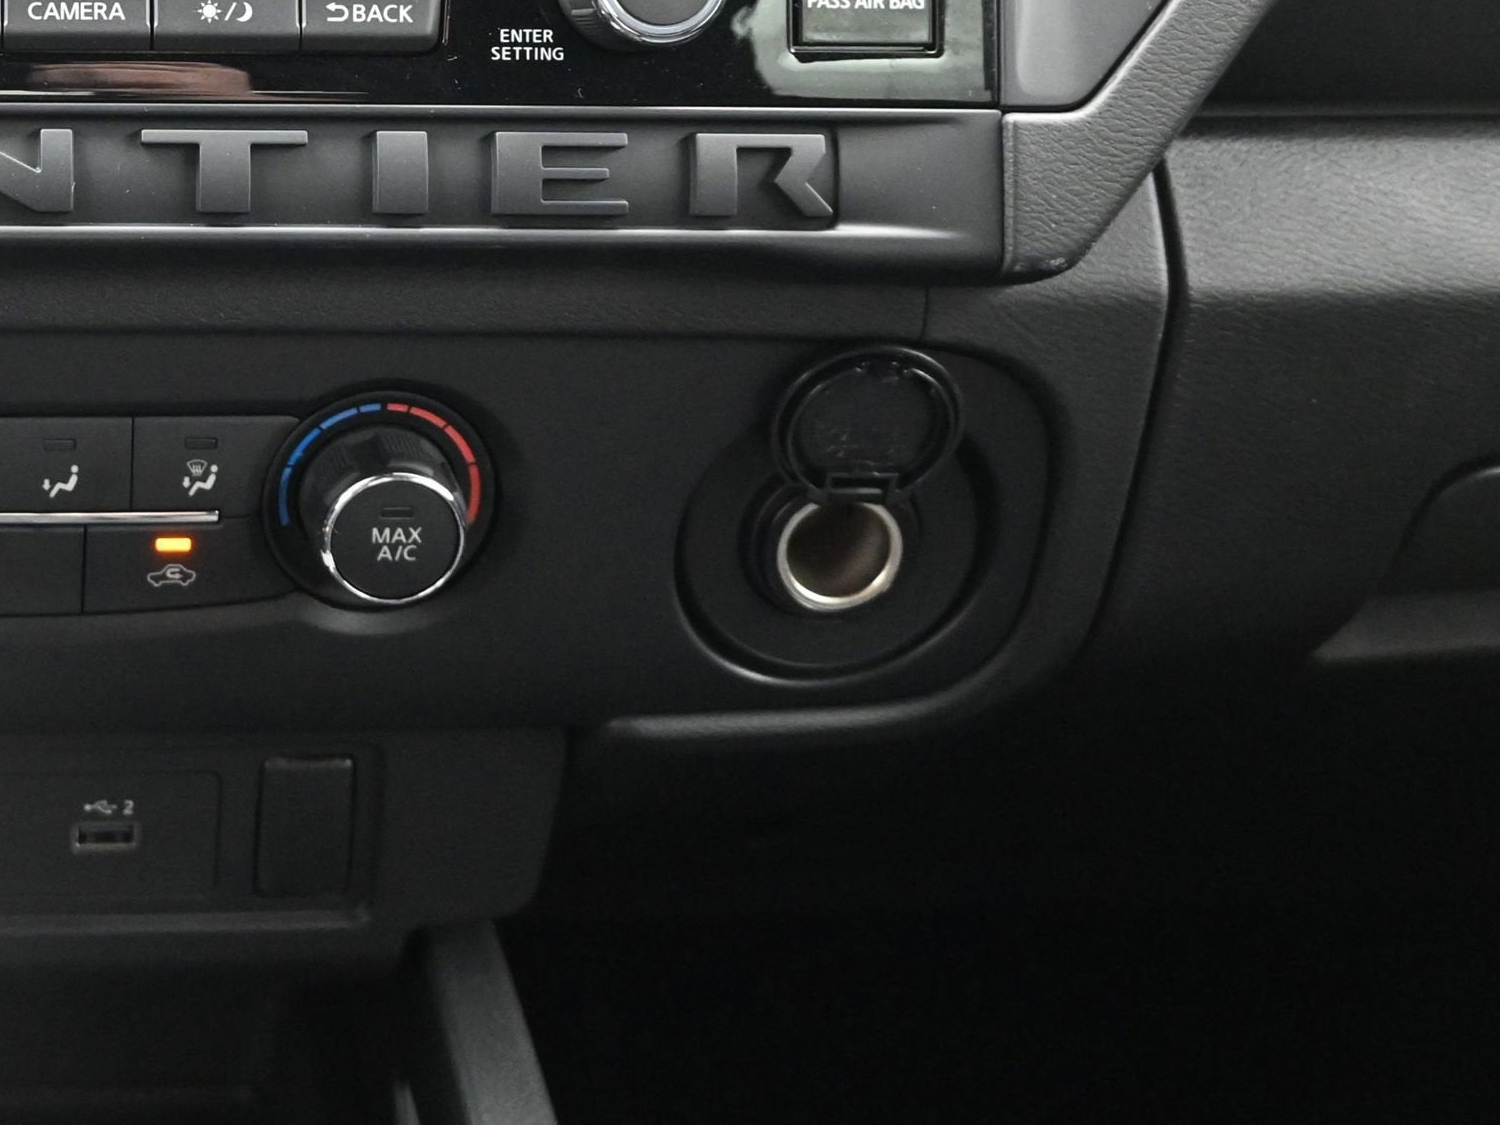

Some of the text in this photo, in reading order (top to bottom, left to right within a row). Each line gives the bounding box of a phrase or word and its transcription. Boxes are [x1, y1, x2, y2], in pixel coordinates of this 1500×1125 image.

[27, 1, 126, 21] CAMERA
[352, 2, 413, 24] BACK
[499, 28, 554, 43] ENTER
[490, 46, 565, 61] SETTING
[371, 526, 422, 543] MAX
[376, 544, 418, 561] A/C
[123, 800, 135, 815] 2
